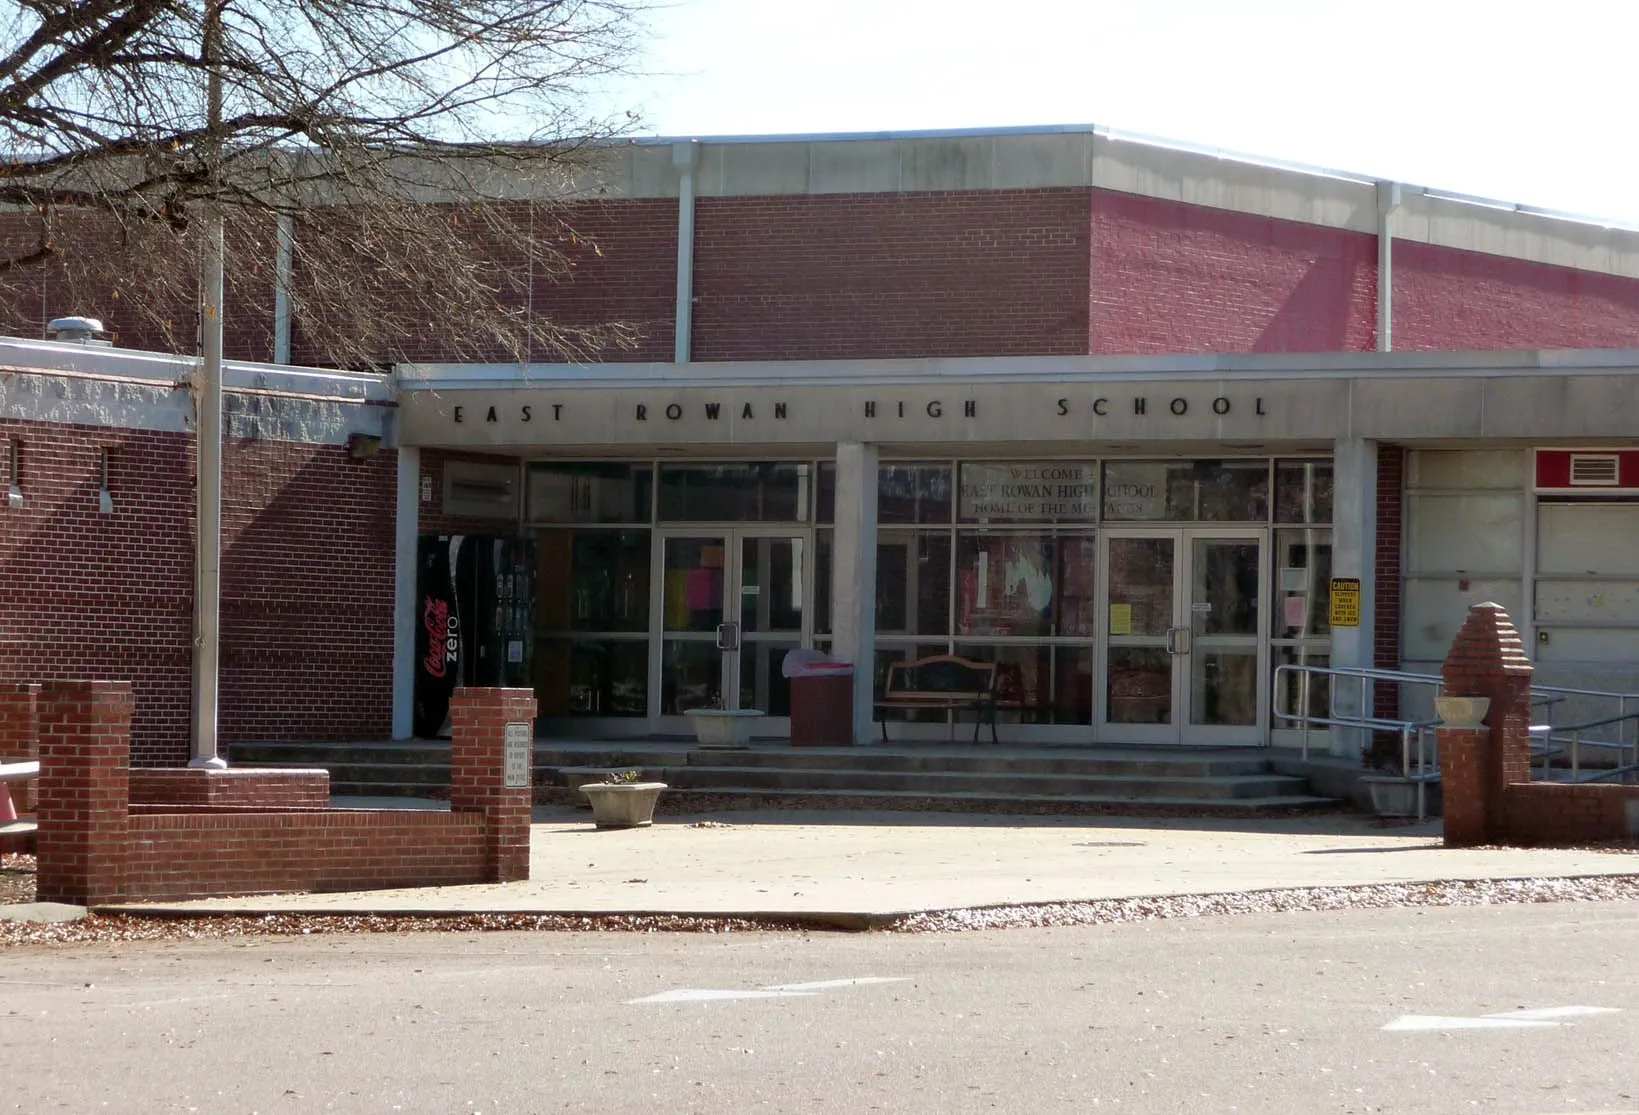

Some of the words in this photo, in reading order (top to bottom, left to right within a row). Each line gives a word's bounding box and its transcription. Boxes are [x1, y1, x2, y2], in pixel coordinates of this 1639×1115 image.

[453, 403, 564, 424] EAST
[635, 402, 787, 421] ROWAN
[864, 400, 977, 419] HIGH
[1056, 397, 1267, 417] SCHOOL
[1010, 468, 1084, 481] WELCOME
[960, 484, 995, 498] EAST
[1001, 484, 1052, 498] ROWAN
[1056, 484, 1096, 498] HIGH
[1105, 484, 1159, 498] CHOOL
[1018, 503, 1035, 514] OF
[1332, 581, 1358, 590] CAUTION
[424, 596, 448, 678] Coca-Cola
[446, 616, 458, 662] zero
